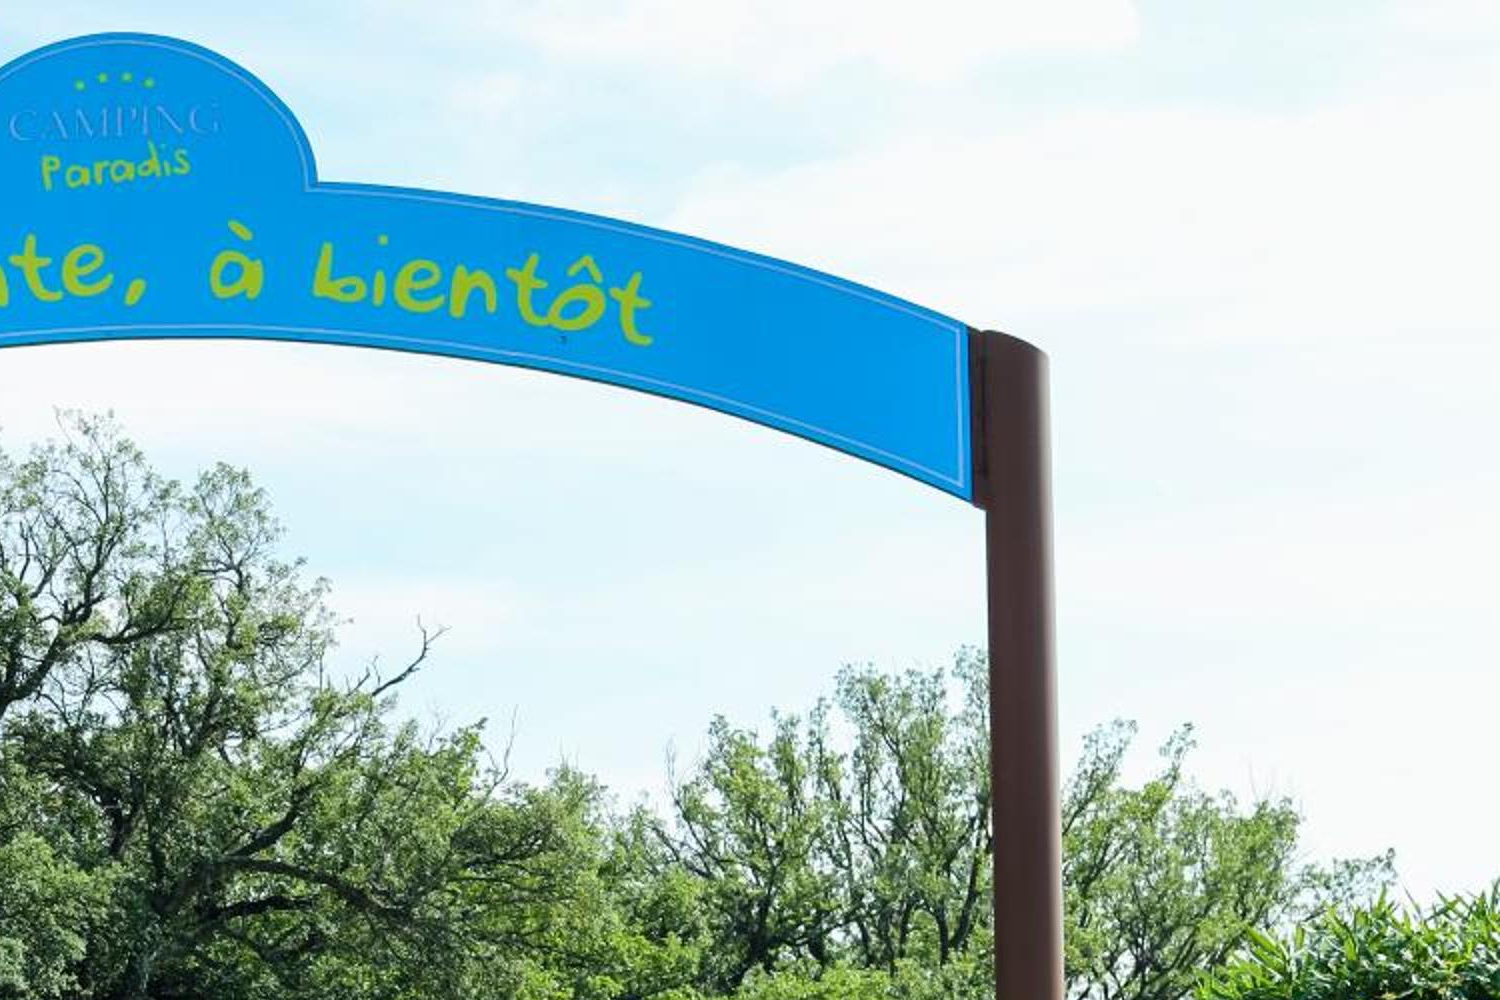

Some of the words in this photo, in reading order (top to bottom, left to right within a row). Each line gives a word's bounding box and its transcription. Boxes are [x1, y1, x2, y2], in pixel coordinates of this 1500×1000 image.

[9, 103, 222, 142] CAMPING
[40, 139, 192, 191] Paradis
[210, 219, 264, 300] à
[313, 234, 654, 346] bientôt
